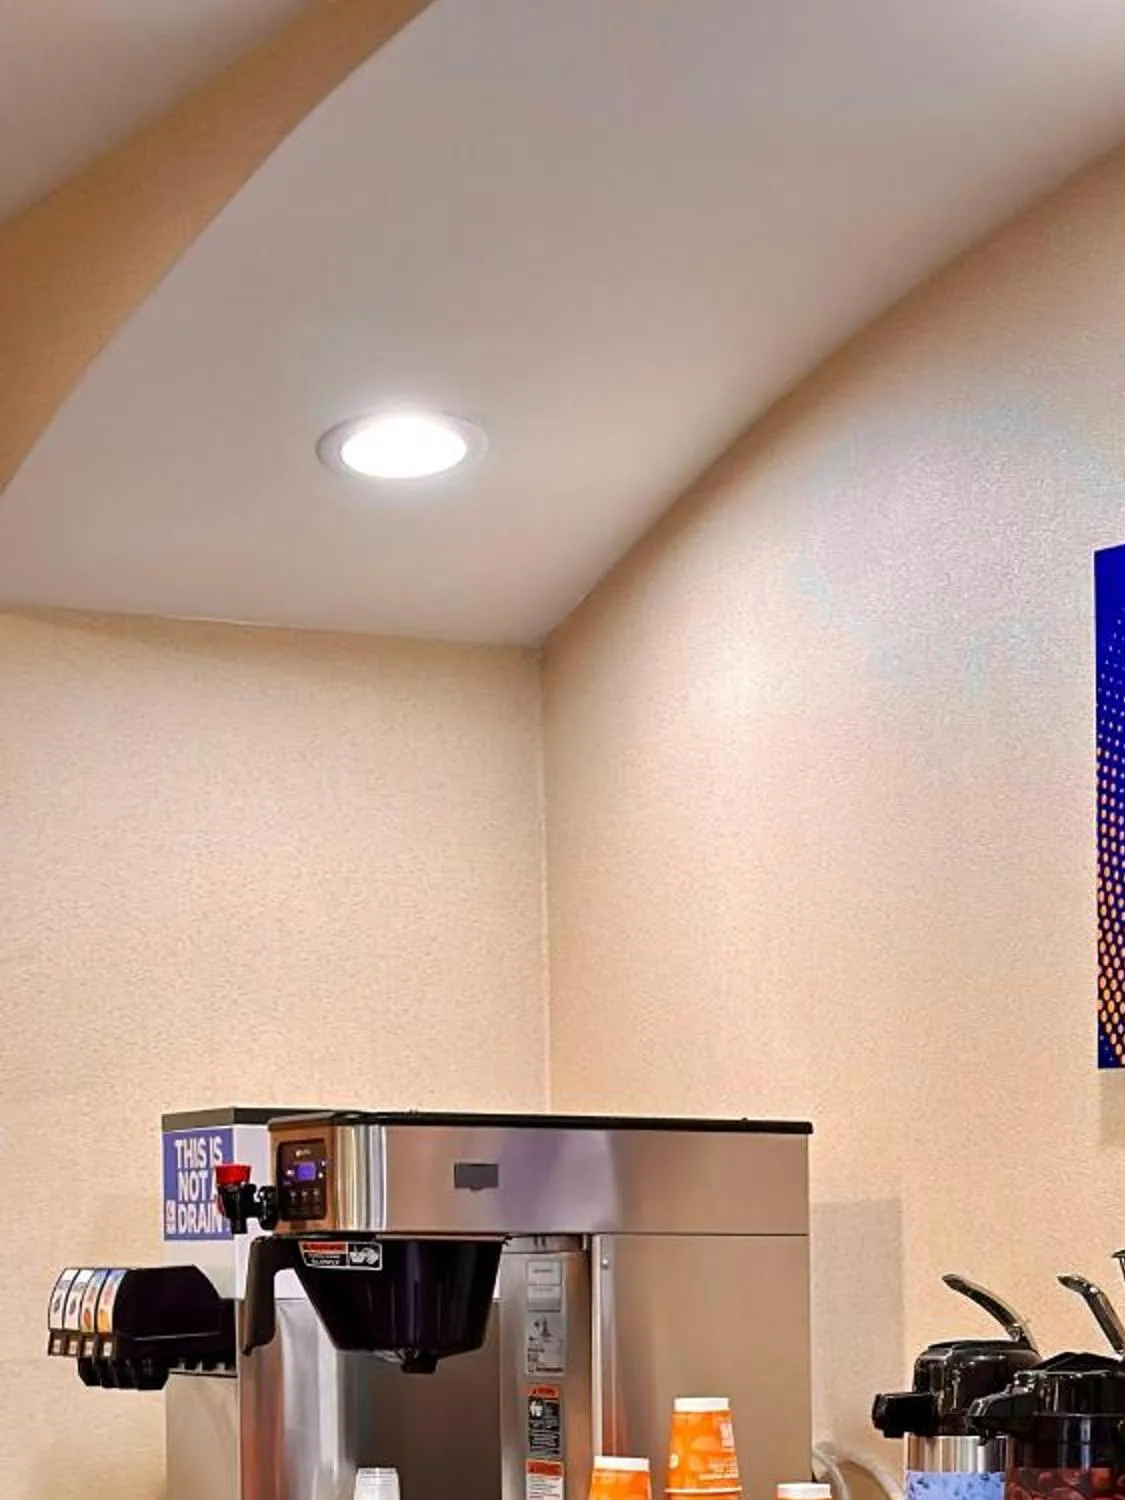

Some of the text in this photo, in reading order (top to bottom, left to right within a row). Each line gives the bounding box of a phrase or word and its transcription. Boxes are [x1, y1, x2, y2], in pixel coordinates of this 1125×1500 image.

[174, 1136, 223, 1169] THIS IS
[178, 1170, 209, 1201] NOT
